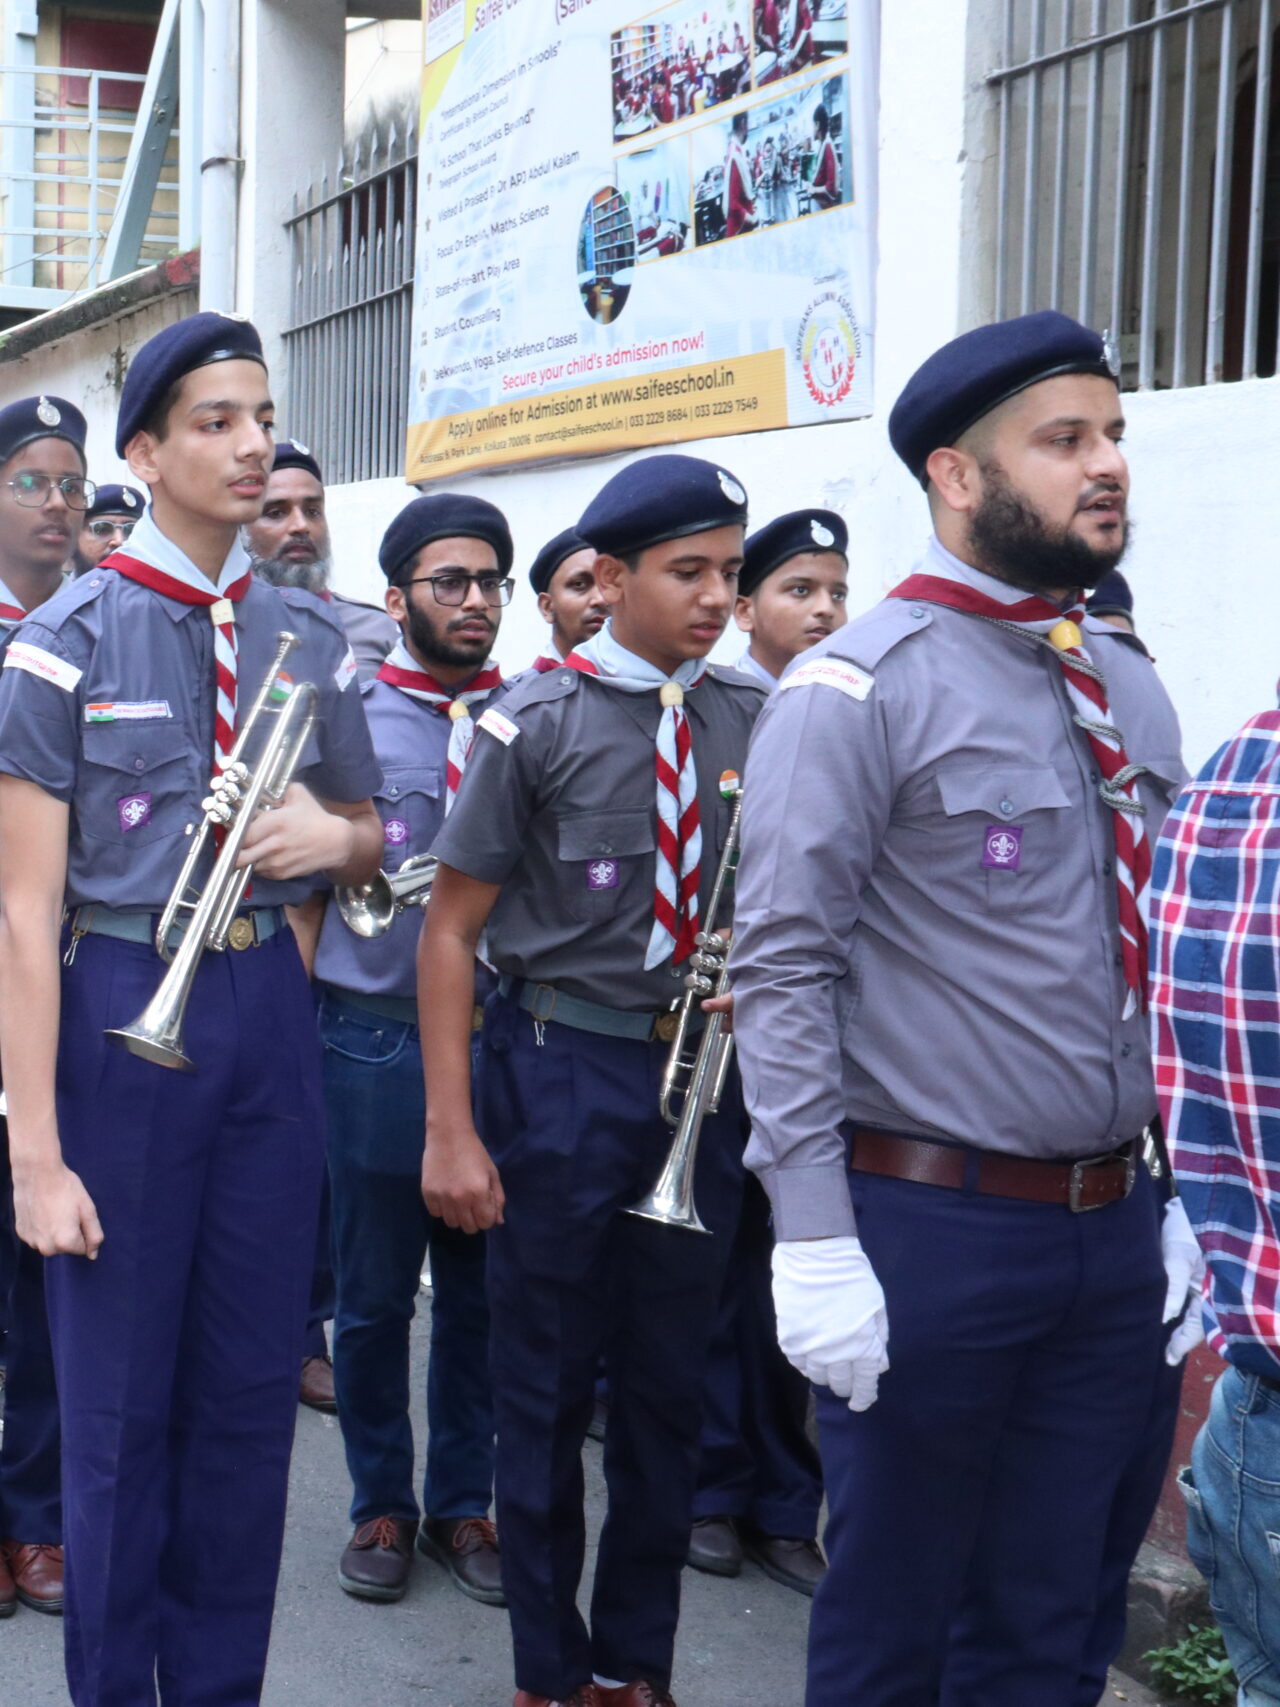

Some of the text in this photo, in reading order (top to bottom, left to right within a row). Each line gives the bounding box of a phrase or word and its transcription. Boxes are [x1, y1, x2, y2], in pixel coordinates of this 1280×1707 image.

[517, 62, 528, 77] in
[552, 150, 581, 170] Kalam
[437, 244, 454, 259] Focus
[518, 204, 551, 226] Science
[503, 257, 521, 273] Area
[496, 342, 545, 364] Self-defence
[546, 332, 579, 351] Classes
[502, 331, 705, 391] Secure your child's admission now!
[447, 365, 736, 440] Apply online for Admission at www.saifeeschool.in
[534, 417, 625, 444] contact@saifeeschool.in
[629, 413, 645, 429] 033
[645, 410, 665, 426] 2229
[666, 407, 689, 422] 8684
[694, 403, 710, 418] 033
[712, 400, 734, 416] 2229
[736, 396, 759, 412] 7549
